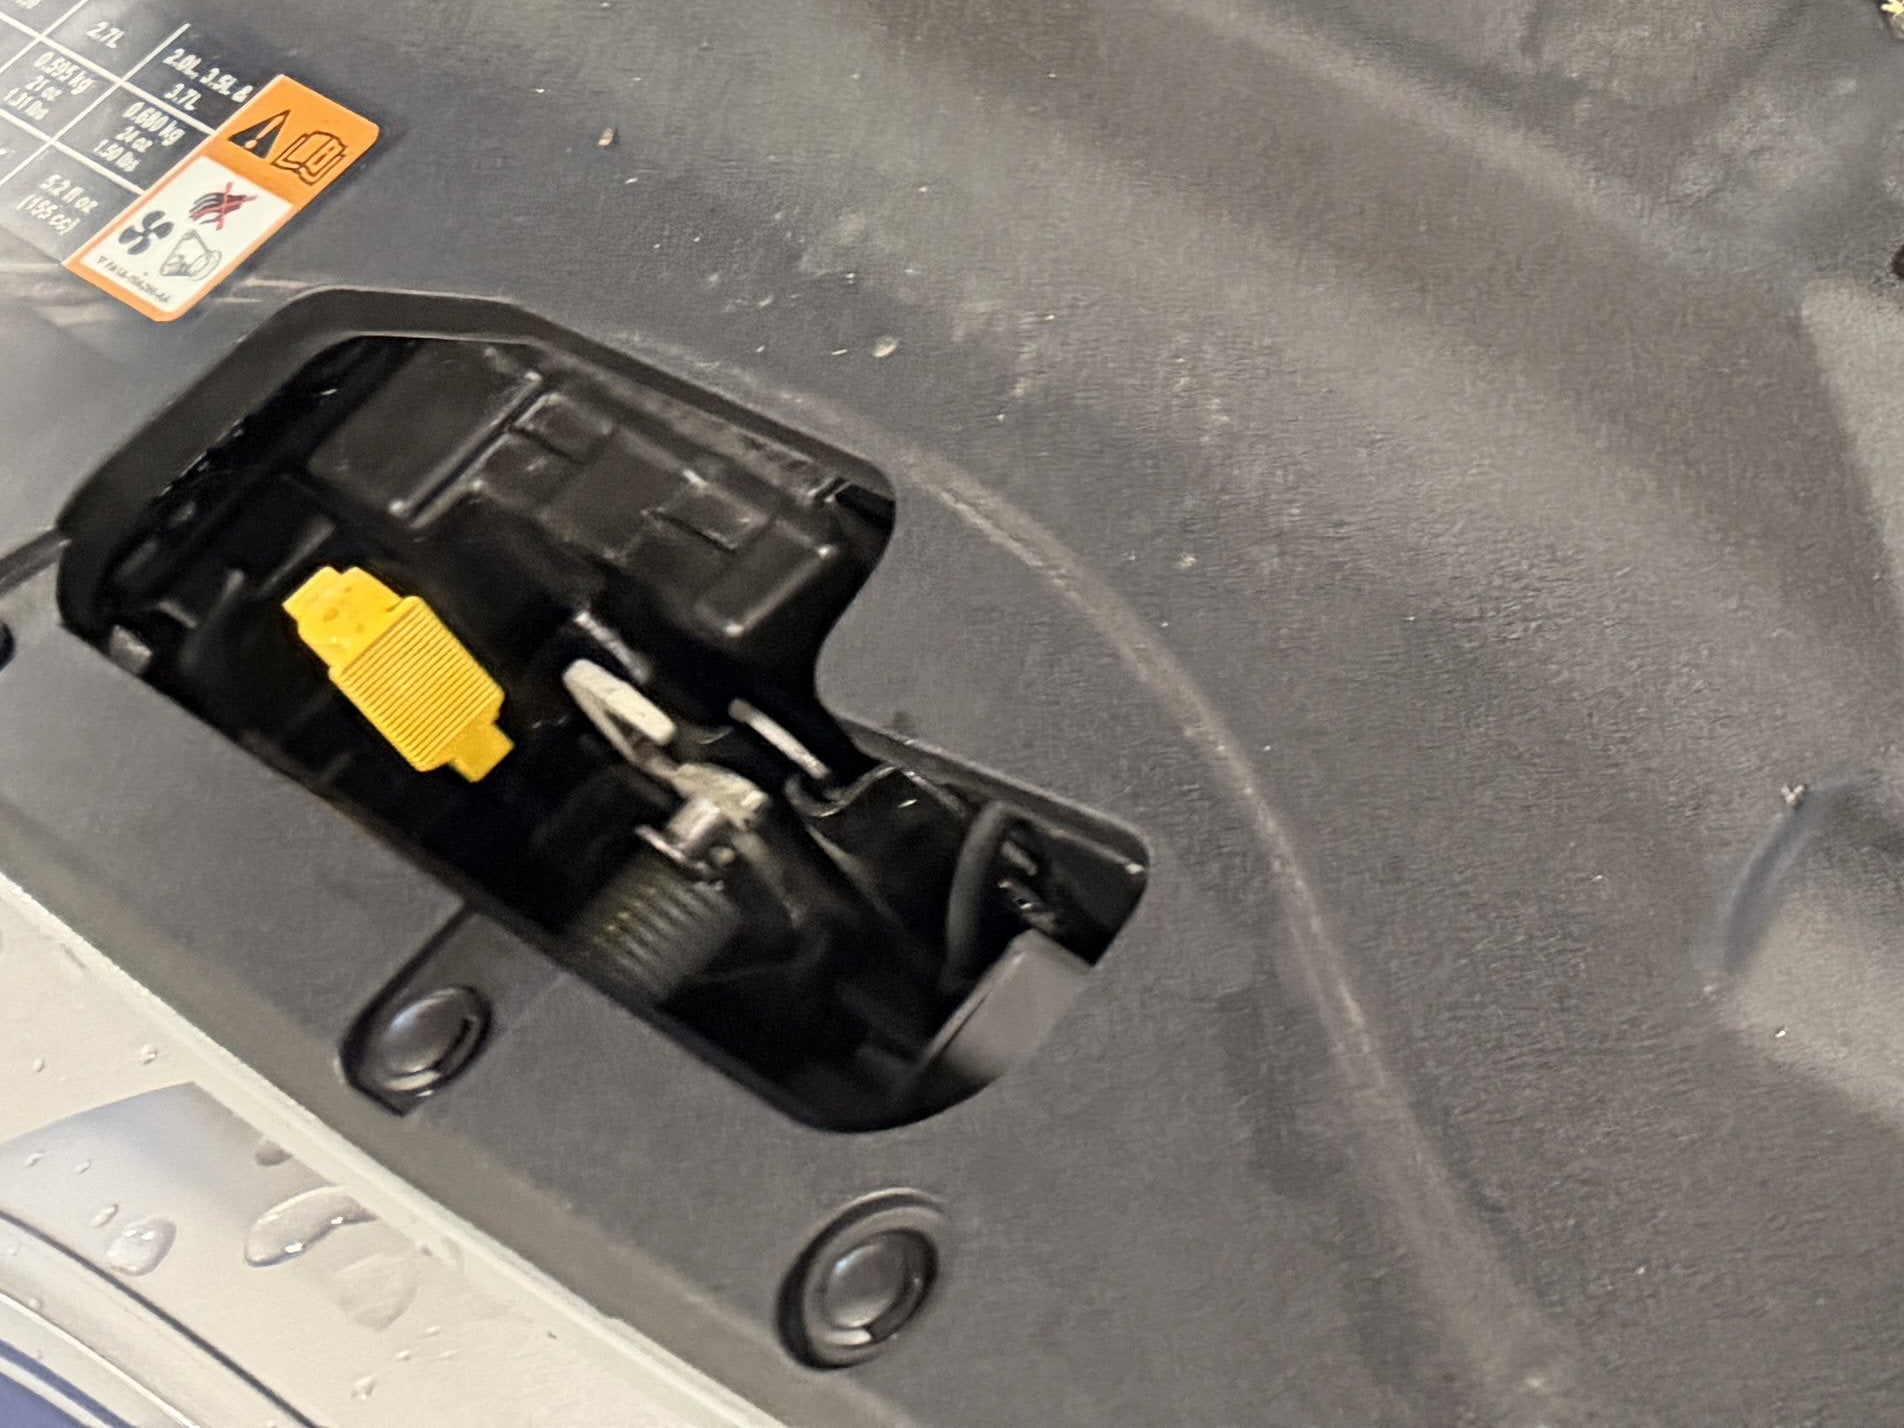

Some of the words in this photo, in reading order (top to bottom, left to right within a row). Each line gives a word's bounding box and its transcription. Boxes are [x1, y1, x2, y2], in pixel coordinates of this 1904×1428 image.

[85, 21, 124, 48] 2.7L
[40, 86, 62, 101] oz
[68, 70, 94, 95] kg
[200, 68, 236, 95] 3.5L
[232, 85, 253, 102] &
[164, 83, 201, 110] 3.7L
[24, 100, 49, 120] lbs
[123, 102, 168, 131] 0.680
[158, 120, 185, 146] kg
[131, 137, 152, 152] oz
[115, 151, 139, 172] lbs
[74, 197, 98, 213] oz
